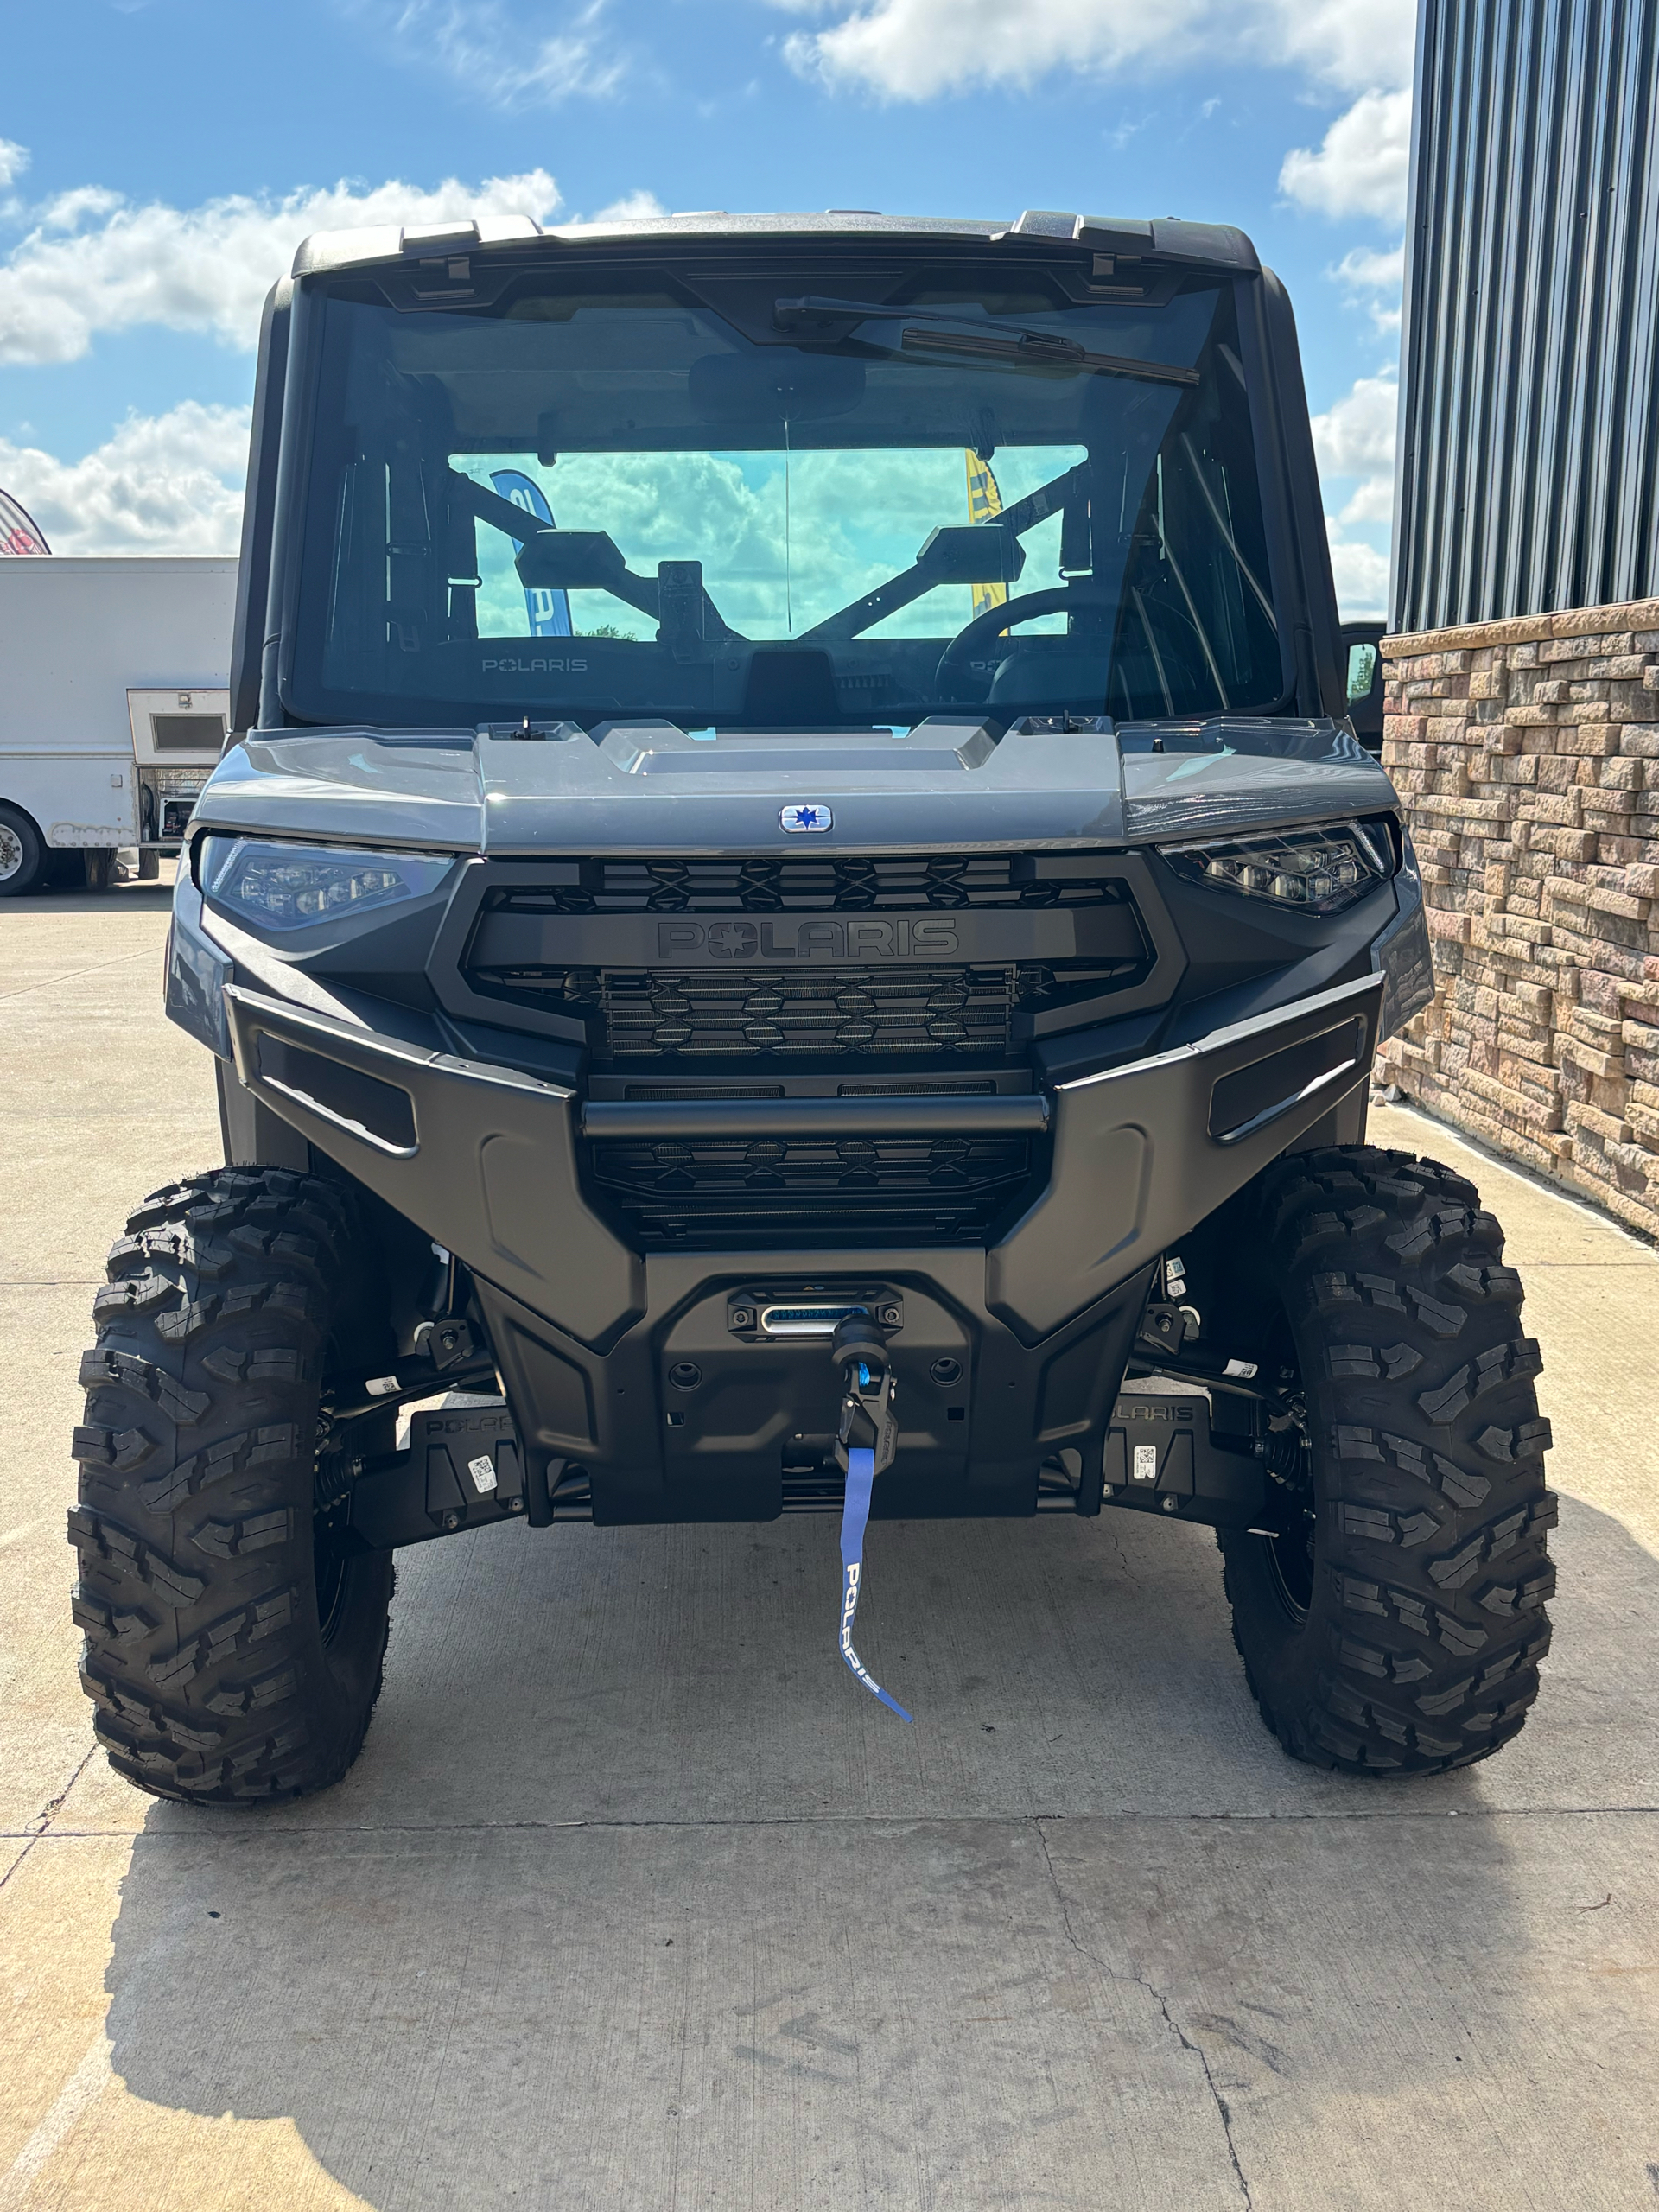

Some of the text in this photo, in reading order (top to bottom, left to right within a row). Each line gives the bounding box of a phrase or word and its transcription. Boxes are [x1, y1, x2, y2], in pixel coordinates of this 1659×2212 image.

[482, 658, 588, 672] POLARIS
[658, 918, 959, 958] POLARIS
[1112, 1405, 1193, 1421] LARIS
[427, 1416, 513, 1435] POLAR
[842, 1562, 881, 1694] POLARIS
